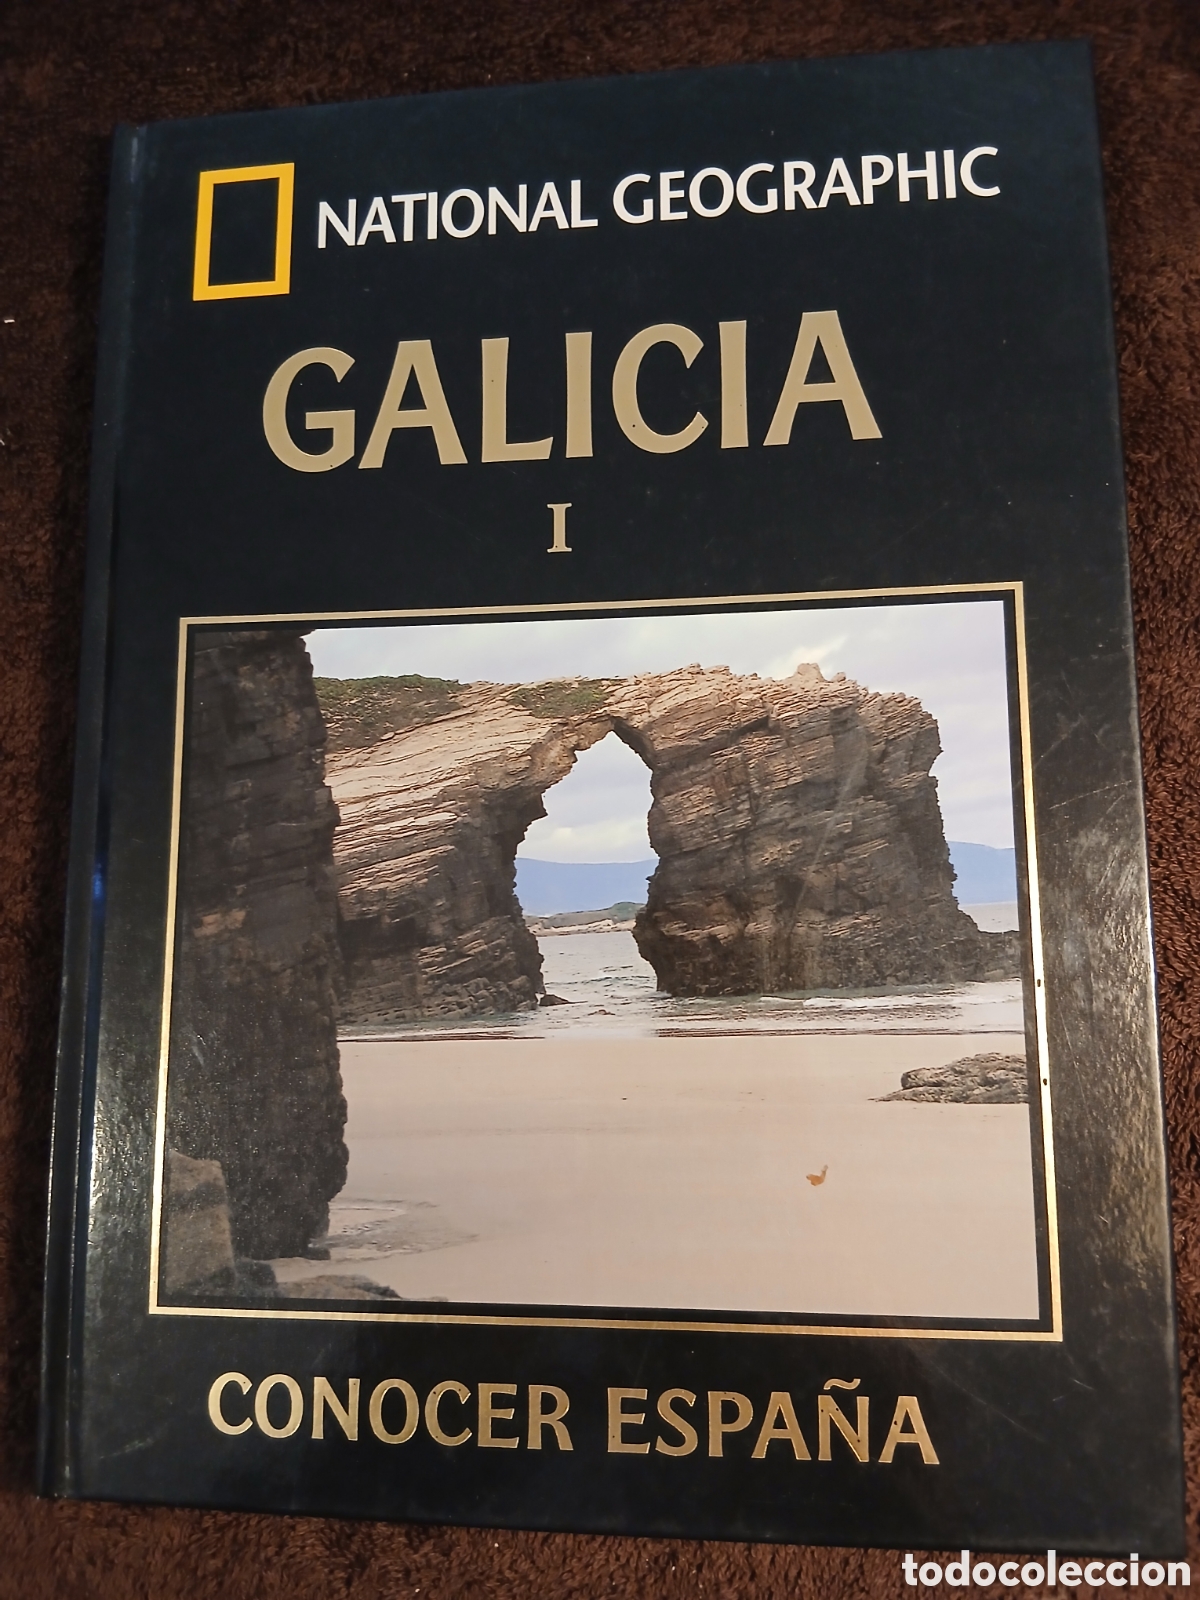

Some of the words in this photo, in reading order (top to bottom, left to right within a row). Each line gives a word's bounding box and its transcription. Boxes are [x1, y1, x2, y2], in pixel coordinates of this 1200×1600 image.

[316, 178, 599, 250] NATIONAL
[612, 145, 1002, 225] GEOGRAPHIC
[262, 309, 883, 474] GALICIA
[546, 502, 573, 555] I
[207, 1371, 575, 1452] CONOCER
[606, 1377, 940, 1466] ESPAÑA
